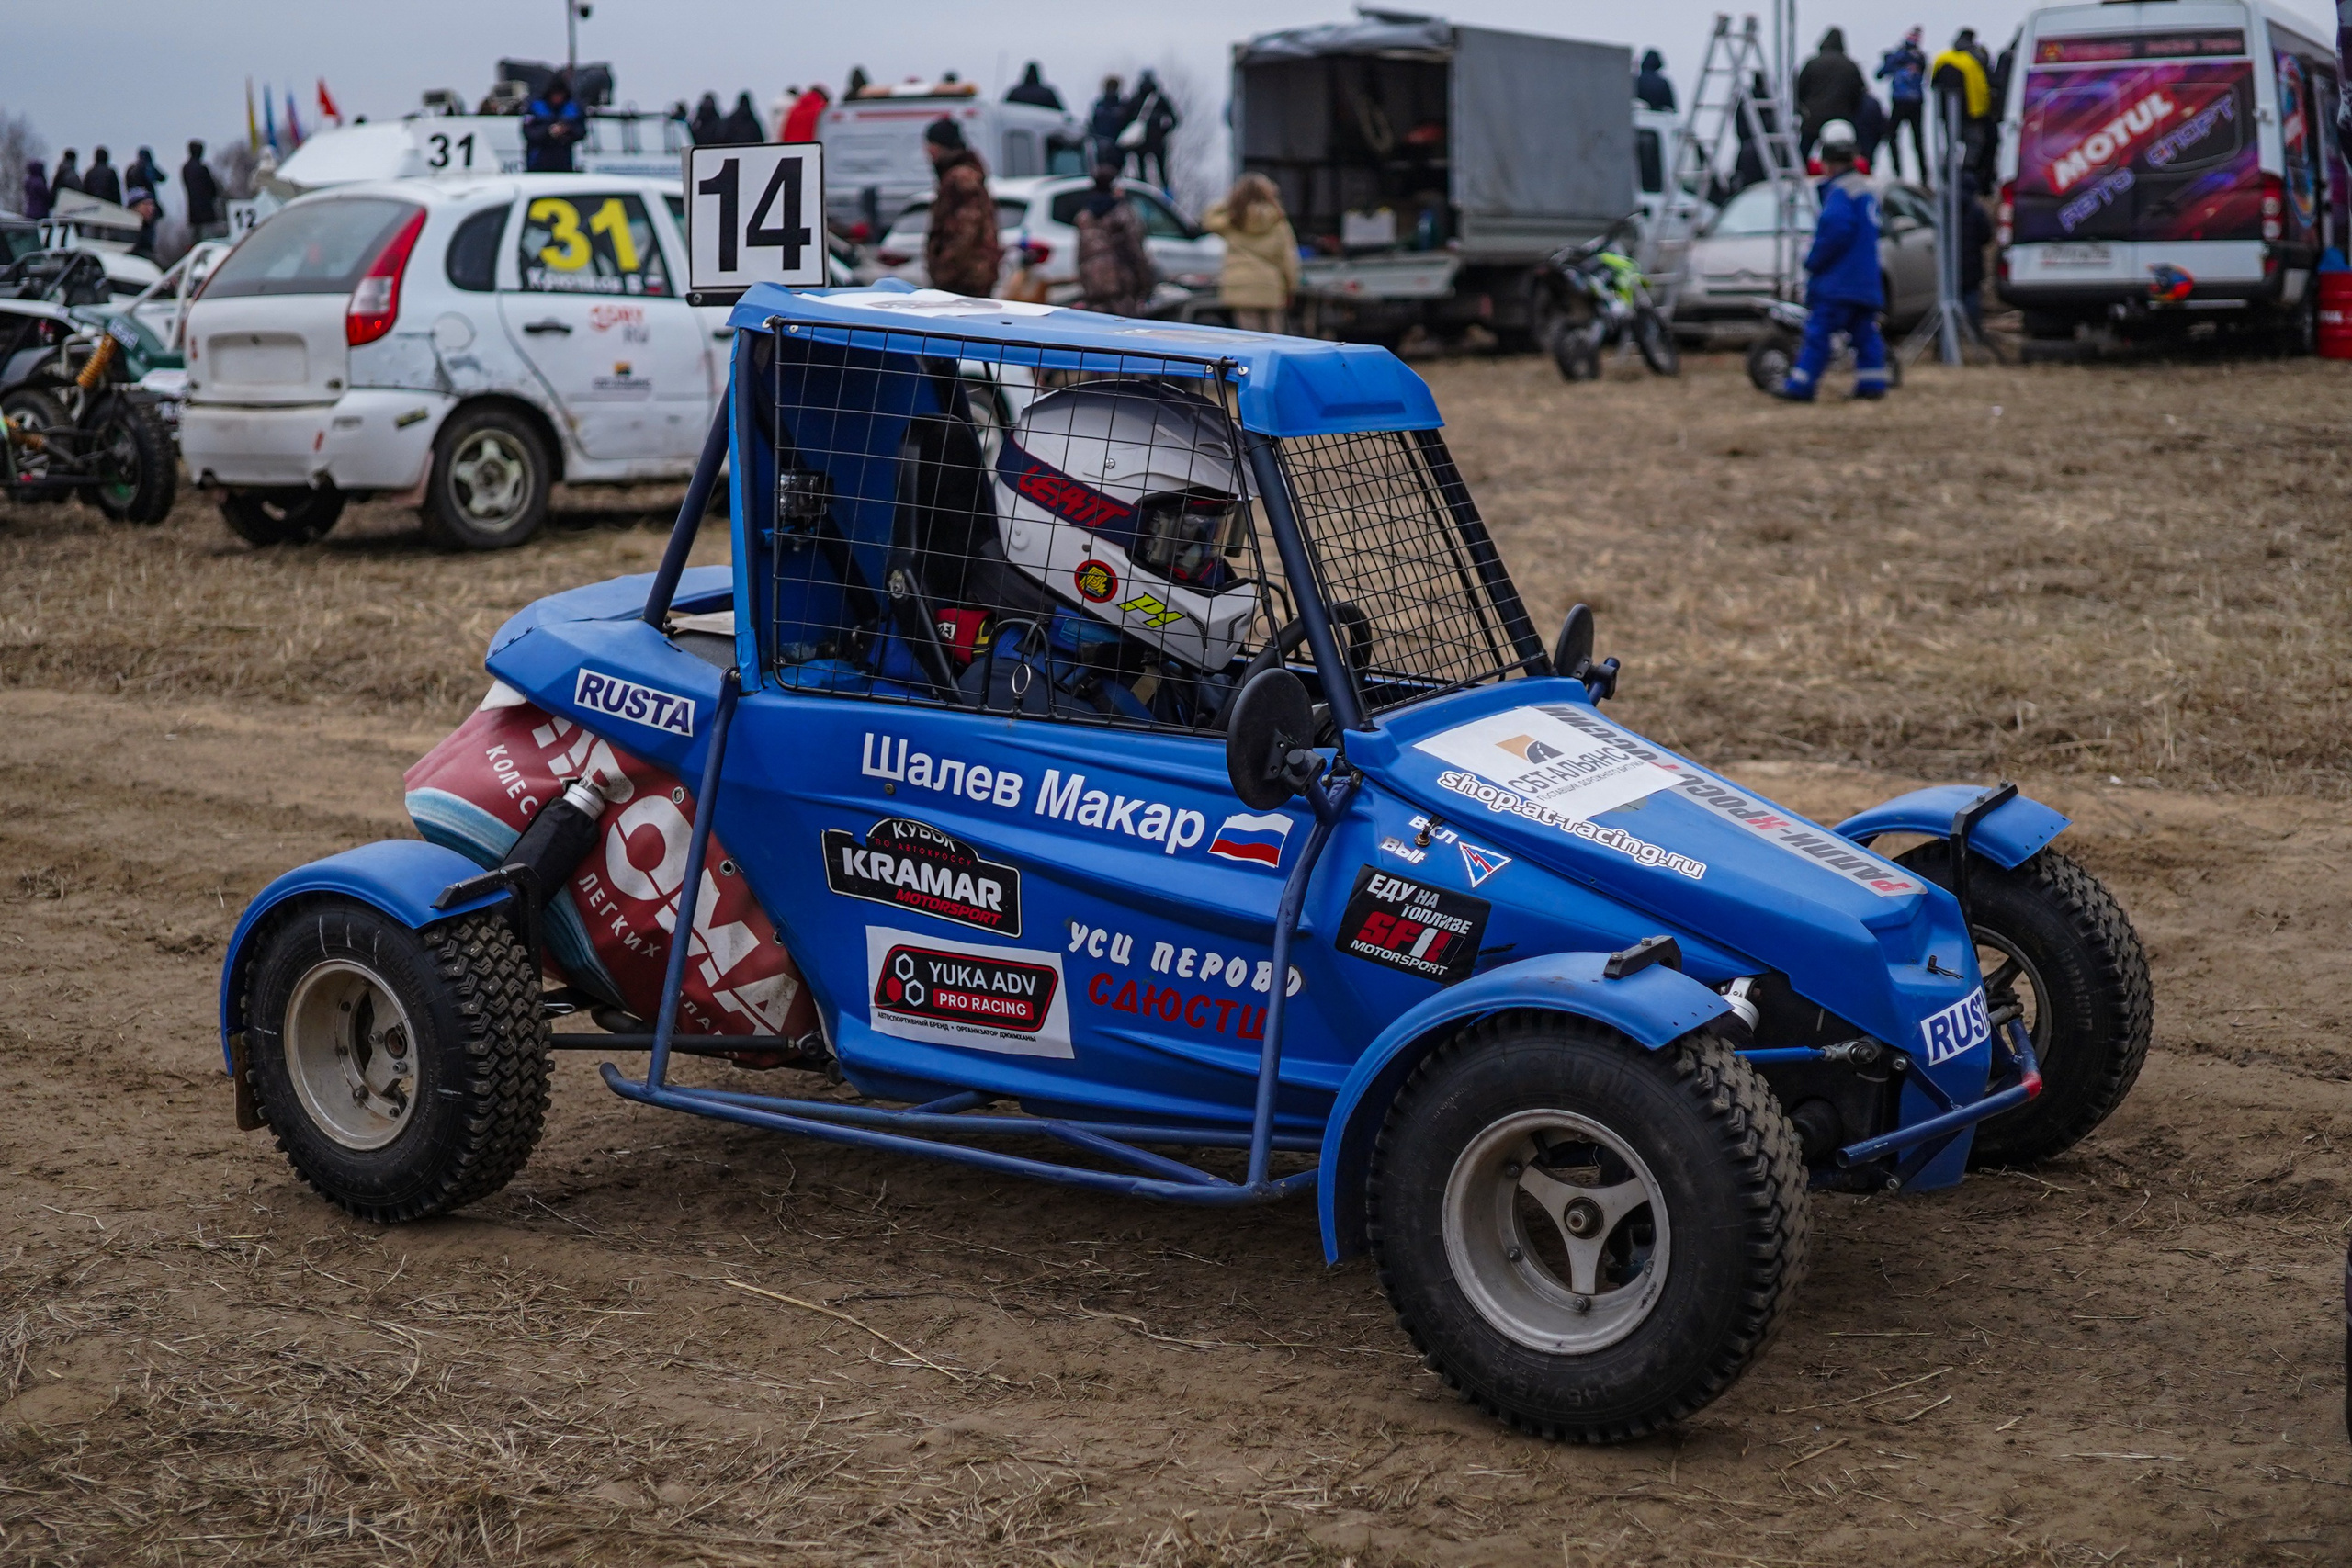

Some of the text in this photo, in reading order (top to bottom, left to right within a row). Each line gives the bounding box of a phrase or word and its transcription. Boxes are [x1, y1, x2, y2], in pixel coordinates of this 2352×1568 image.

[428, 132, 474, 168] 31
[2053, 91, 2175, 188] MOTUL
[233, 207, 258, 230] 12
[528, 197, 640, 272] 31
[698, 156, 812, 273] 14
[1018, 464, 1131, 527] LEATT
[577, 672, 691, 734] RUSTA
[1507, 746, 1632, 795] СБТ-АЛЬЯНС
[861, 732, 1206, 854] Шалев Макар
[892, 821, 956, 852] КУБОК
[1437, 771, 1707, 879] shop.at-racing.ru
[485, 743, 662, 958] КОЛЕС ЛЕГКИХ
[874, 837, 972, 866] ПО АВТОКРОССУ
[842, 846, 1002, 912] KRAMAR
[1367, 874, 1441, 908] ЕДУ НА
[895, 888, 1002, 926] MOTORSPORT
[1401, 903, 1473, 935] ТОПЛИВЕ
[1068, 920, 1134, 966] УСЦ
[1350, 940, 1449, 976] MOTORSPORT
[928, 961, 1037, 996] YUKA ADV
[877, 1011, 929, 1028] АВТОСПОРТИВНЫЙ
[929, 1021, 950, 1032] БРЕНД
[956, 1025, 999, 1037] ОРГАНИЗАТОР
[939, 992, 1027, 1017] PRO RACING
